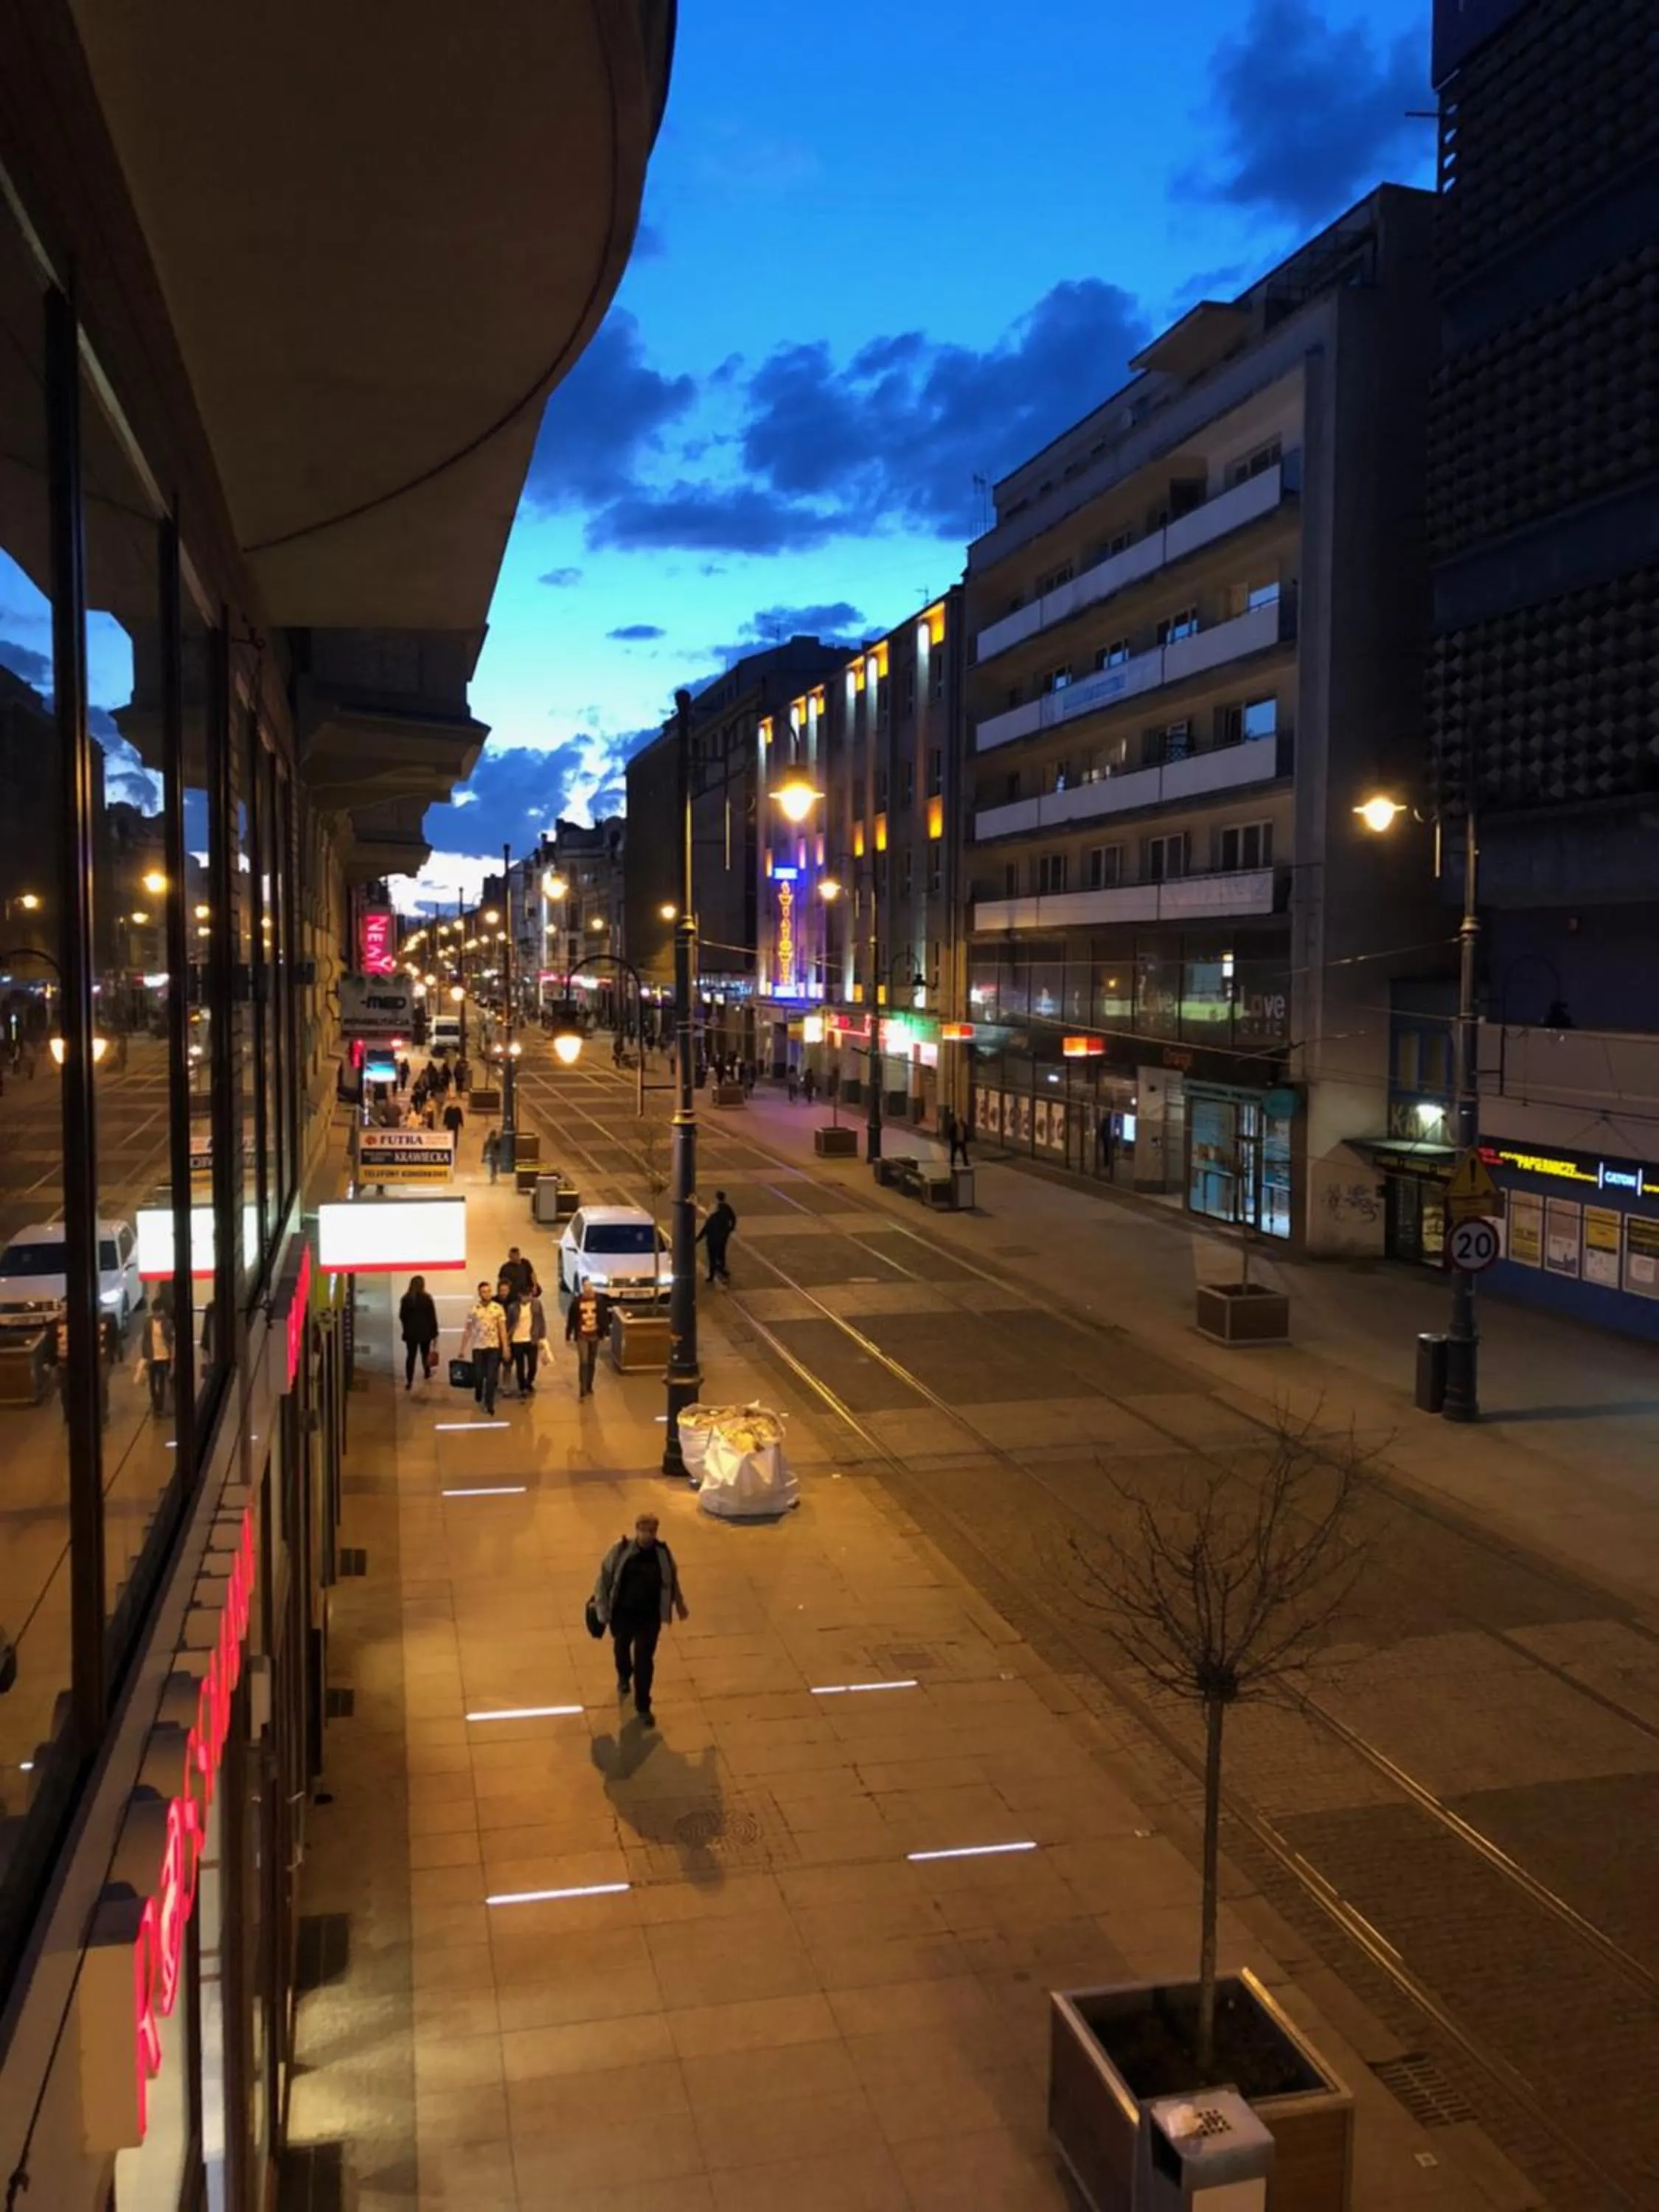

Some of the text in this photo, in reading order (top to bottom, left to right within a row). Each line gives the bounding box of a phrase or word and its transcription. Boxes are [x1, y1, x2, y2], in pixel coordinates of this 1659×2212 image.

[380, 1135, 423, 1145] FUTRA
[394, 1151, 450, 1163] KRAWIECKA
[1457, 1232, 1492, 1259] 20
